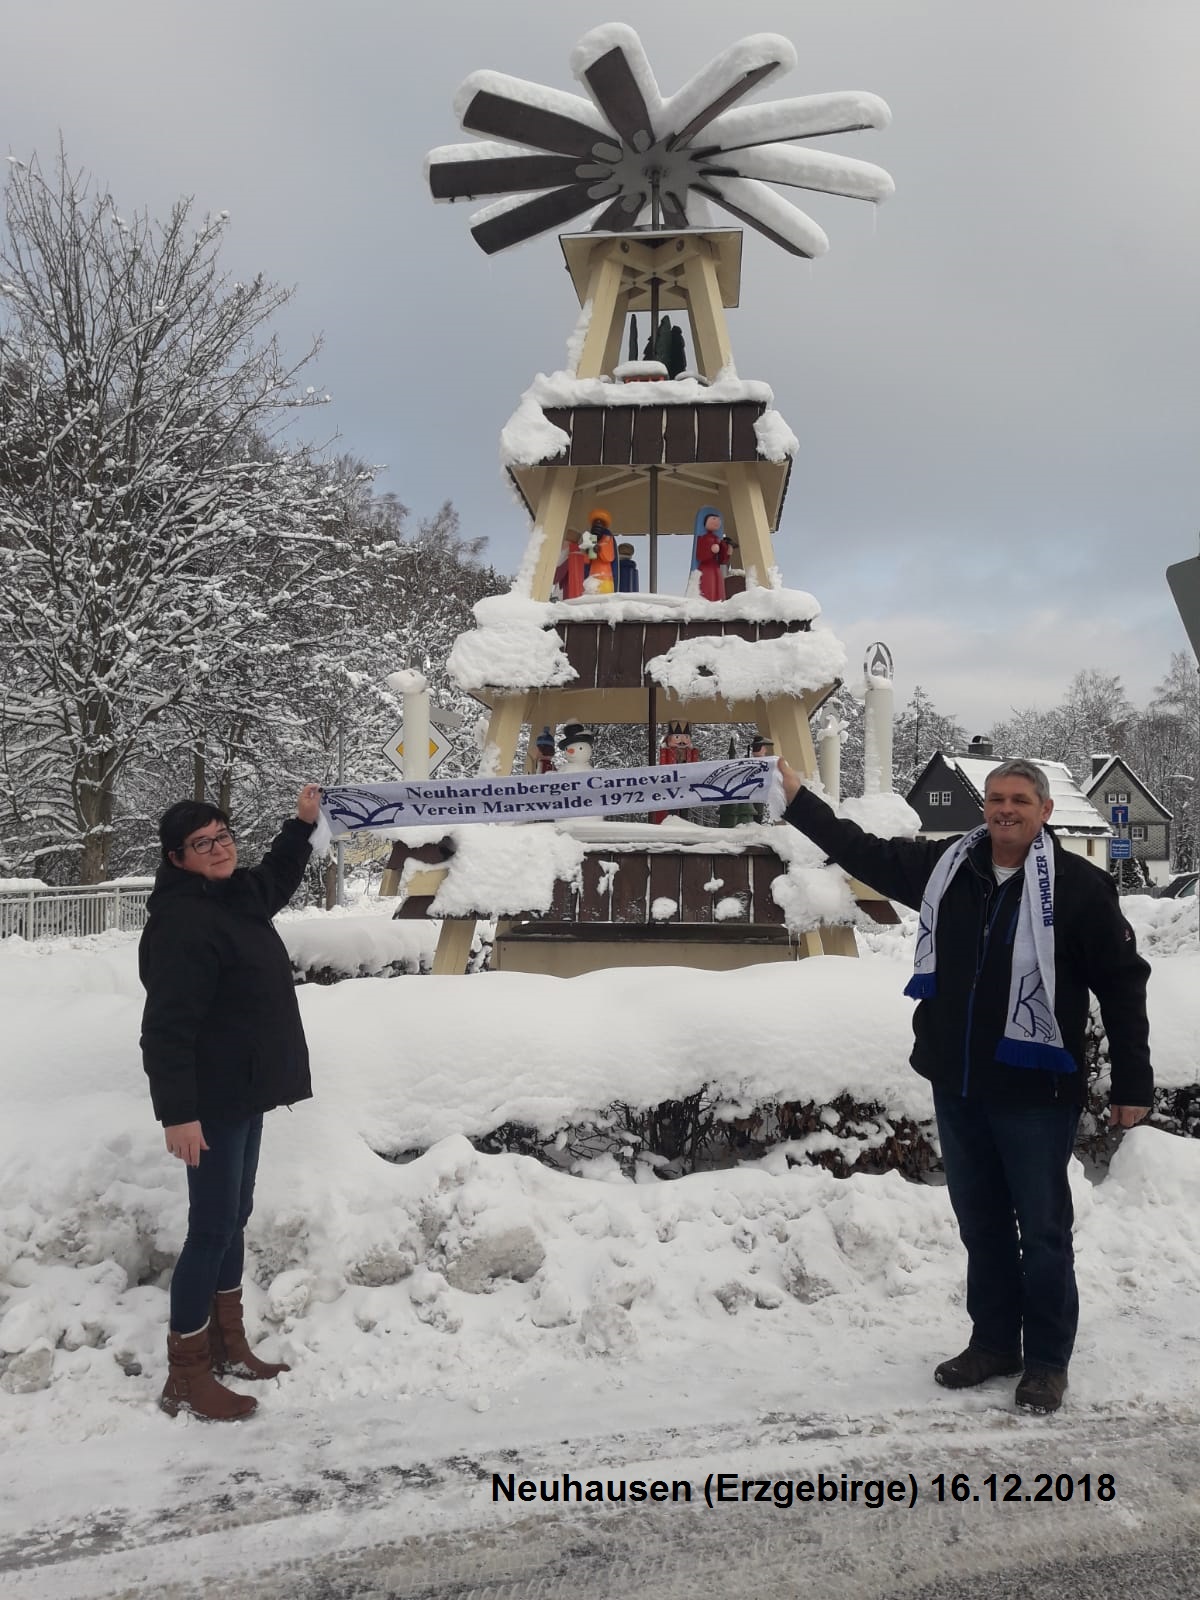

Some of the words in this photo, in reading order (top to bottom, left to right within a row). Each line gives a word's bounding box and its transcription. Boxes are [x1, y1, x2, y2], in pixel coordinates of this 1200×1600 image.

[405, 779, 581, 800] Neuhardenberger
[586, 770, 687, 790] Carneval-
[412, 802, 476, 816] Verein
[482, 795, 593, 814] Marxwalde
[600, 791, 645, 807] 1972
[651, 787, 684, 801] e.V.
[1035, 854, 1054, 927] BUCHHOLZER
